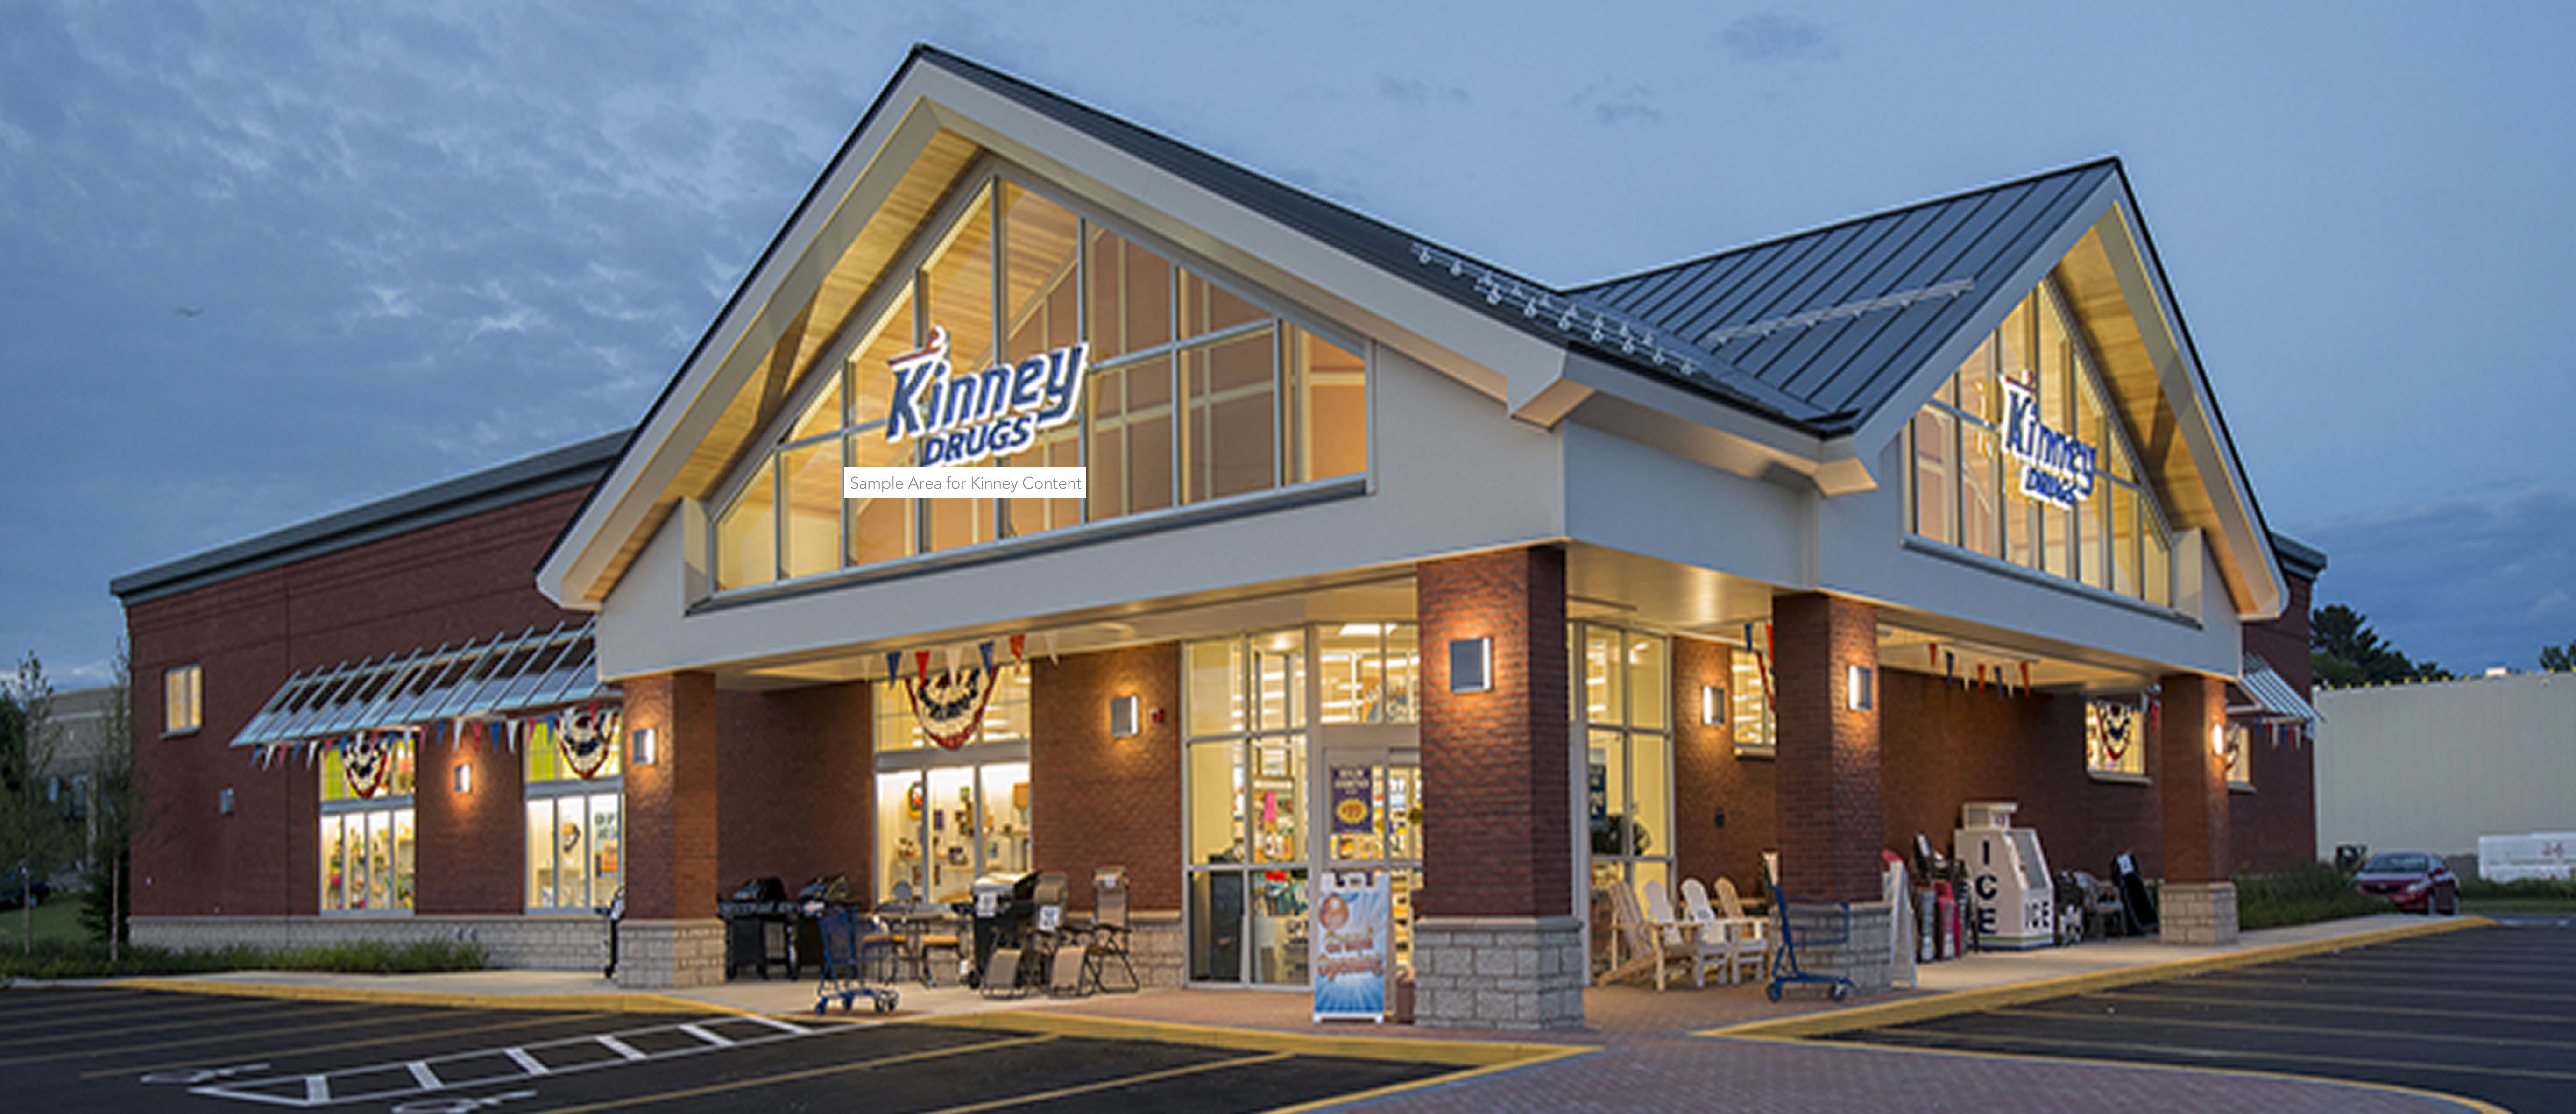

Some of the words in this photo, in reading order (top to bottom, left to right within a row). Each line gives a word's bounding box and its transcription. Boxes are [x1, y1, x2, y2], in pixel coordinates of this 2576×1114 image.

[887, 345, 1086, 439] Kinney
[923, 416, 1031, 466] DRUGS
[2006, 389, 2096, 497] Kinney
[1975, 840, 1997, 933] ICE
[2024, 900, 2050, 928] ICE
